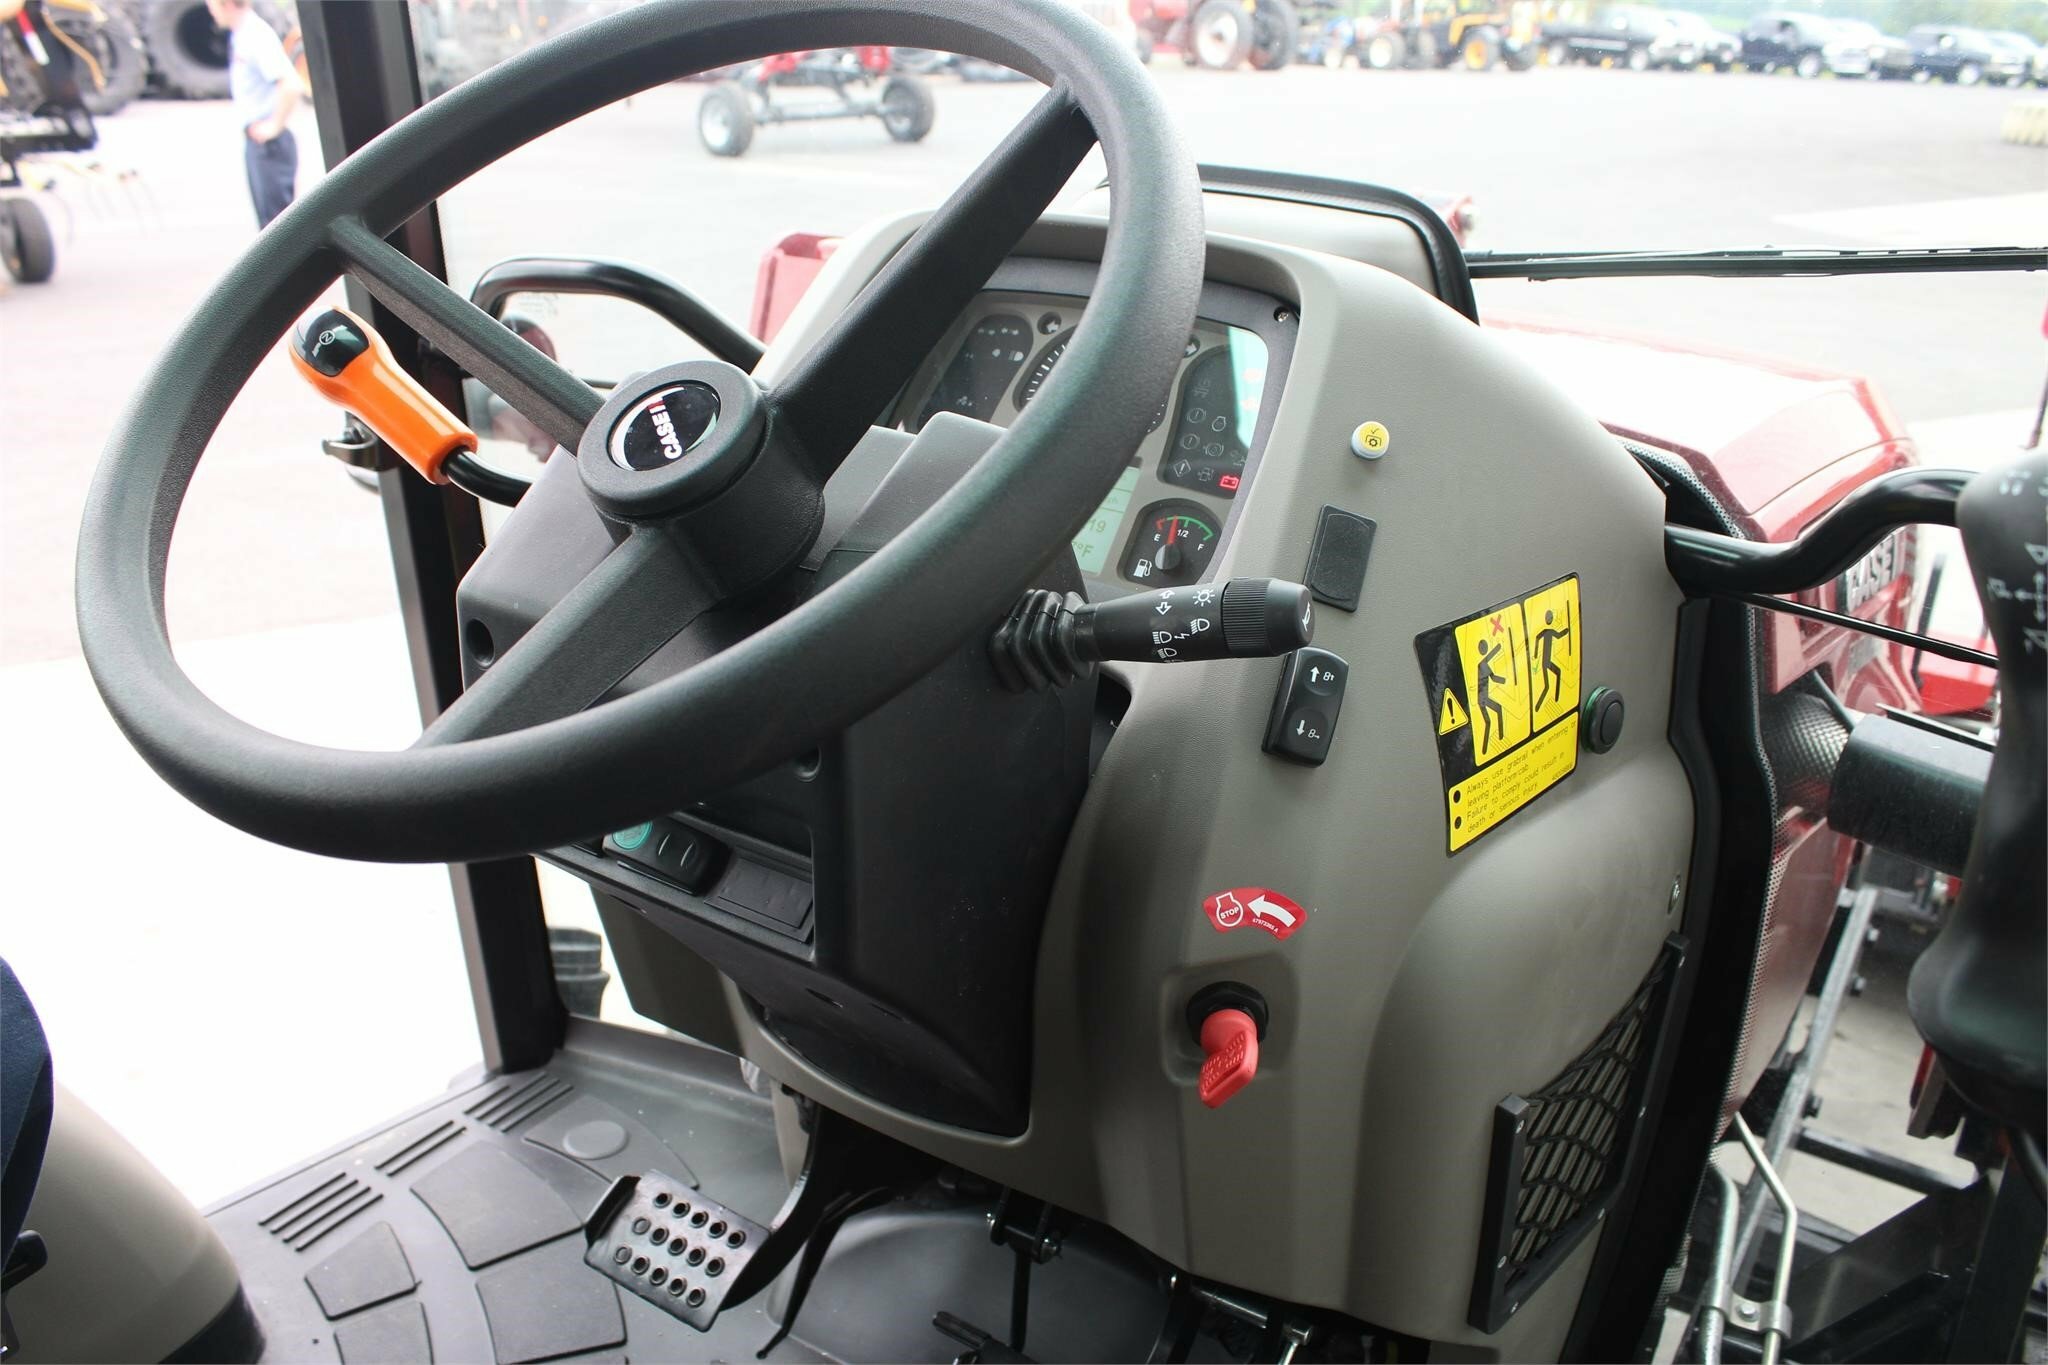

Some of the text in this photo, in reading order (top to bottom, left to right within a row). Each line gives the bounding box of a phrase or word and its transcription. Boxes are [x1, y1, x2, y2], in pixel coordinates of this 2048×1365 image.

[652, 410, 683, 460] CASE
[1154, 534, 1161, 542] E
[1177, 529, 1190, 539] 1/2
[1467, 778, 1489, 795] Always
[1491, 768, 1504, 780] use
[1467, 804, 1488, 819] Failure
[1524, 768, 1539, 783] could
[1467, 790, 1490, 807] leaving
[1467, 817, 1486, 833] death
[1489, 810, 1496, 819] or
[1220, 906, 1240, 920] STOP
